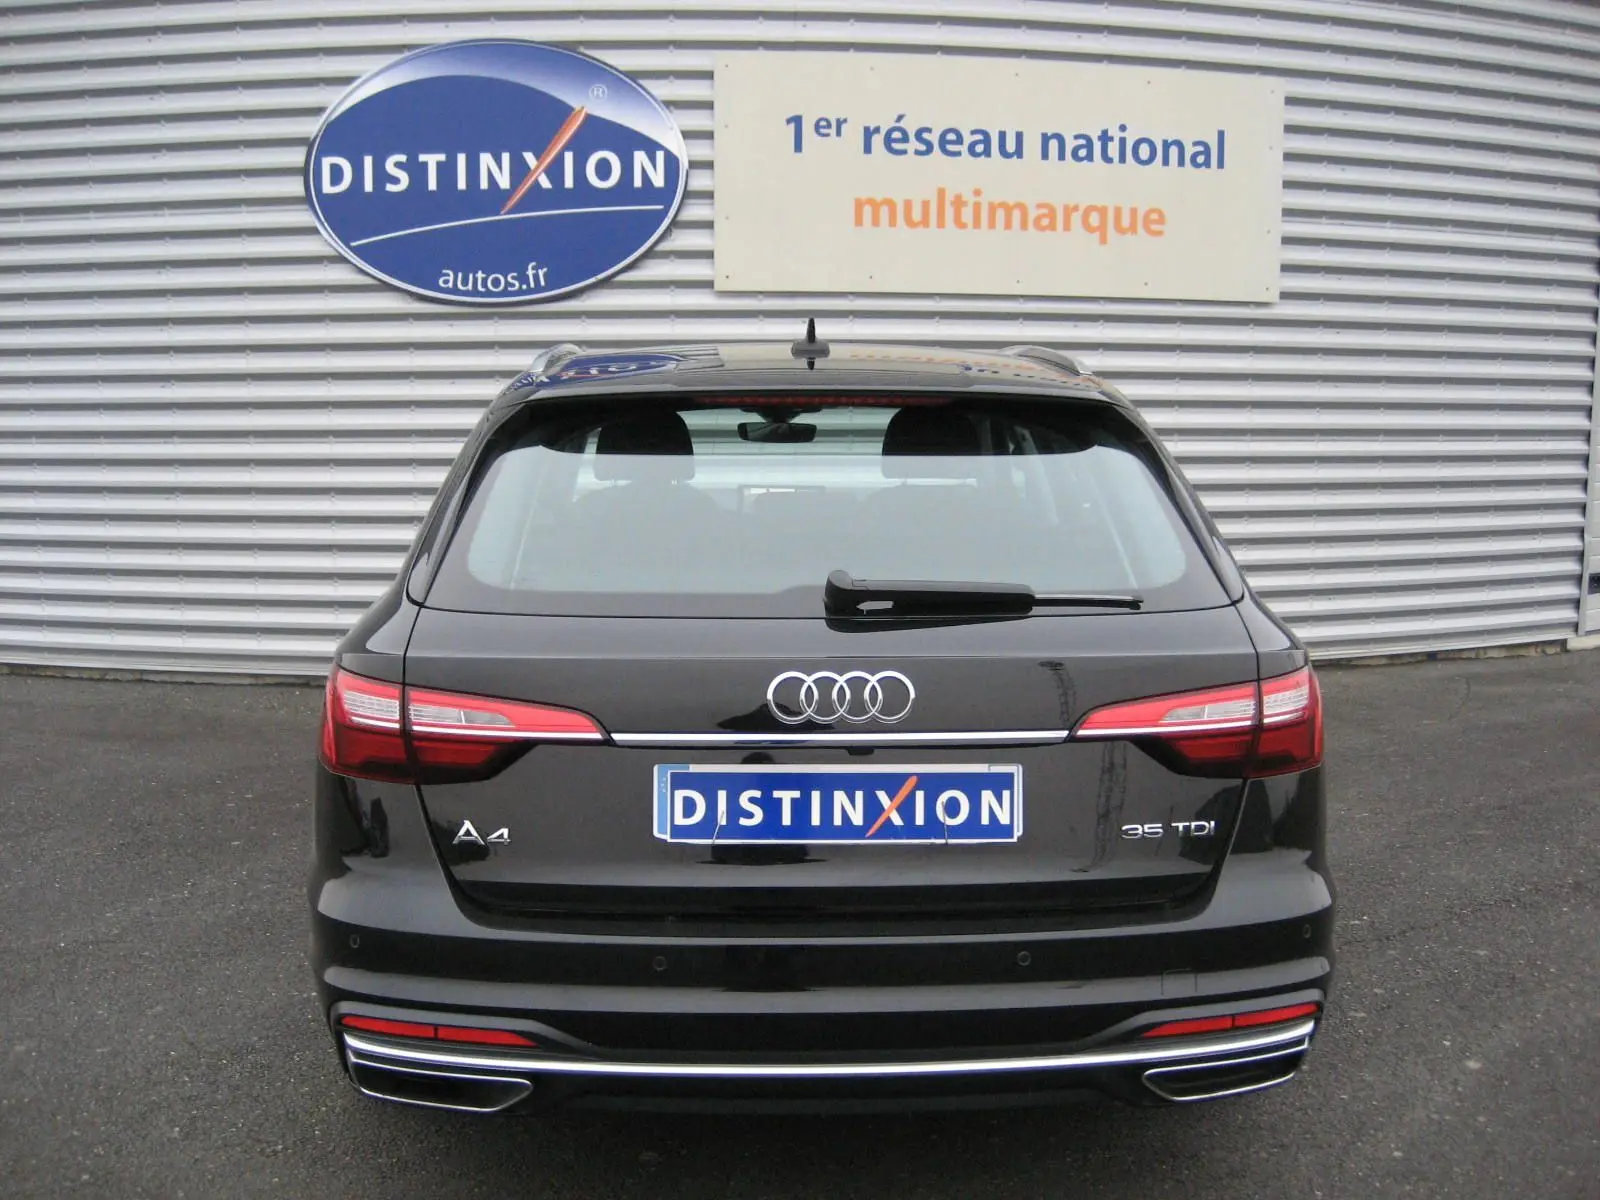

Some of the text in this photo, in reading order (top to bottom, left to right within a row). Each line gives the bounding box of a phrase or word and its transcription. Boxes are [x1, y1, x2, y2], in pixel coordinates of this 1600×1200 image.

[862, 114, 1024, 159] réseau
[1040, 124, 1226, 170] national
[320, 150, 666, 195] DISTINXION
[853, 187, 1167, 245] multimarque
[438, 261, 549, 293] autos.fr
[673, 790, 1012, 828] DISTINXION
[1121, 820, 1216, 839] 35 TDI
